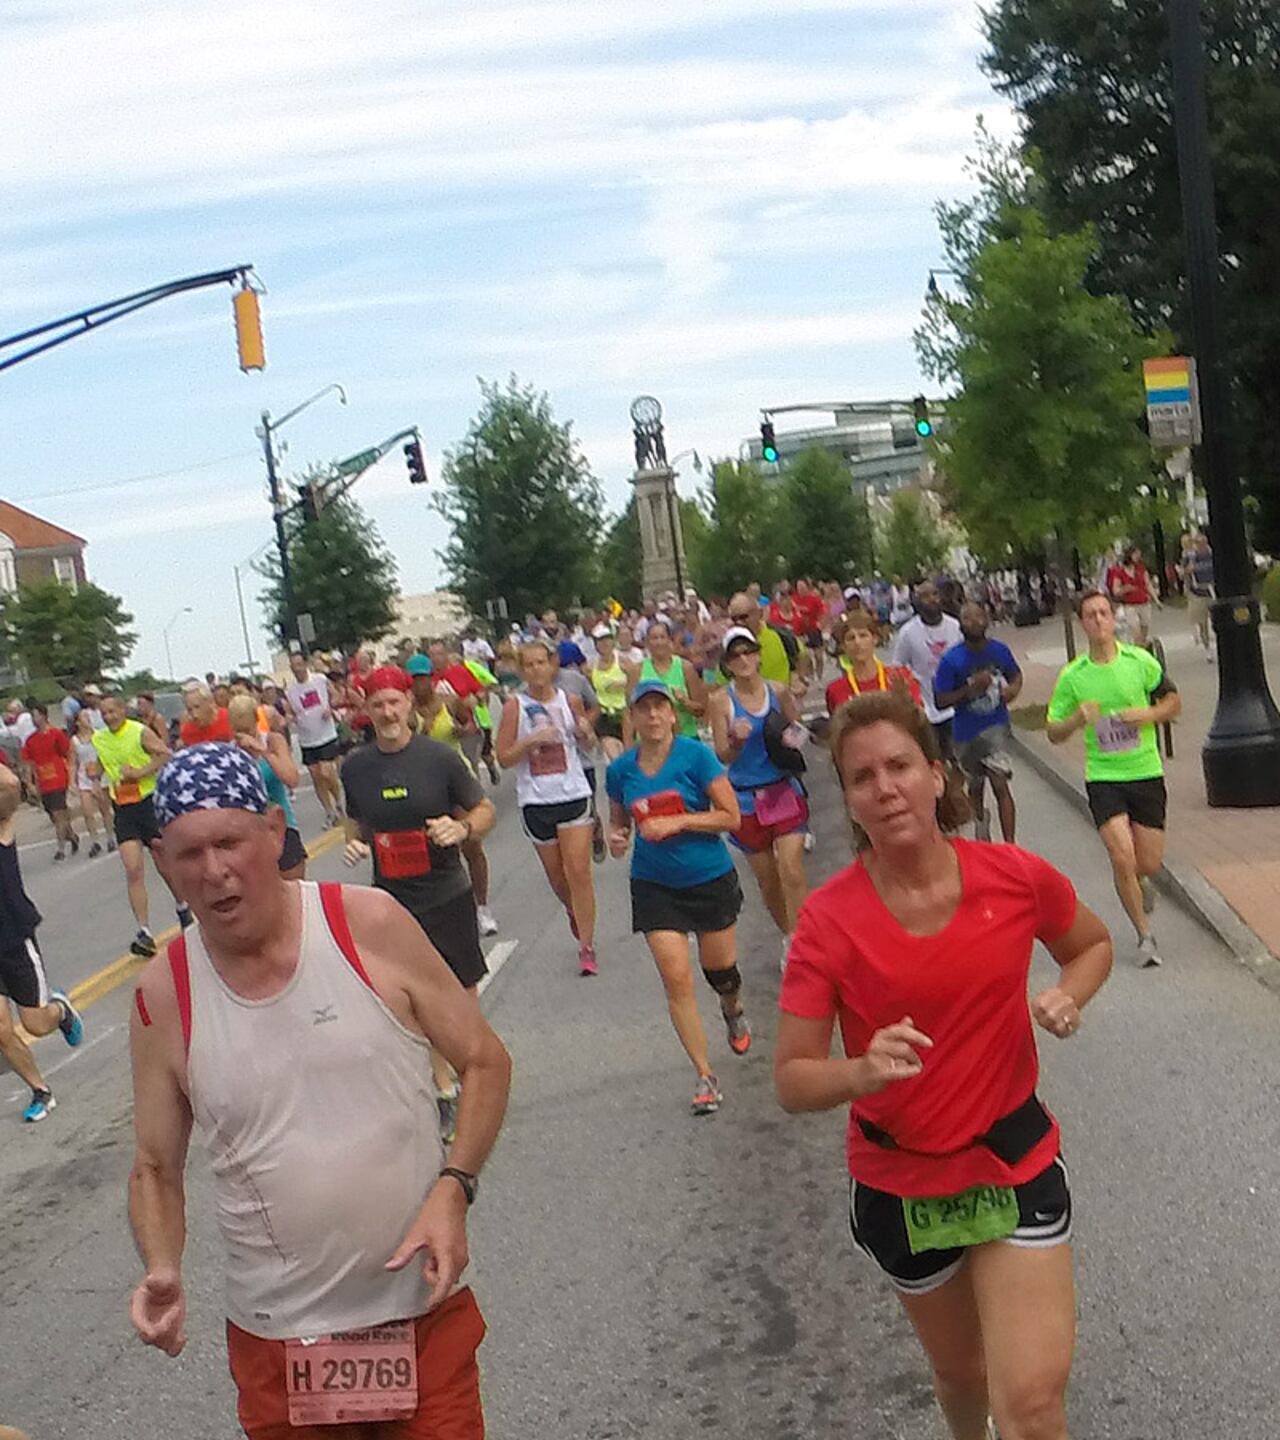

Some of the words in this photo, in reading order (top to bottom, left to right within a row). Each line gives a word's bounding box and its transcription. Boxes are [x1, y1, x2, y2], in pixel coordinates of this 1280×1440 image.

[910, 1200, 931, 1229] G
[292, 1359, 312, 1391] H
[322, 1357, 411, 1390] 29769
